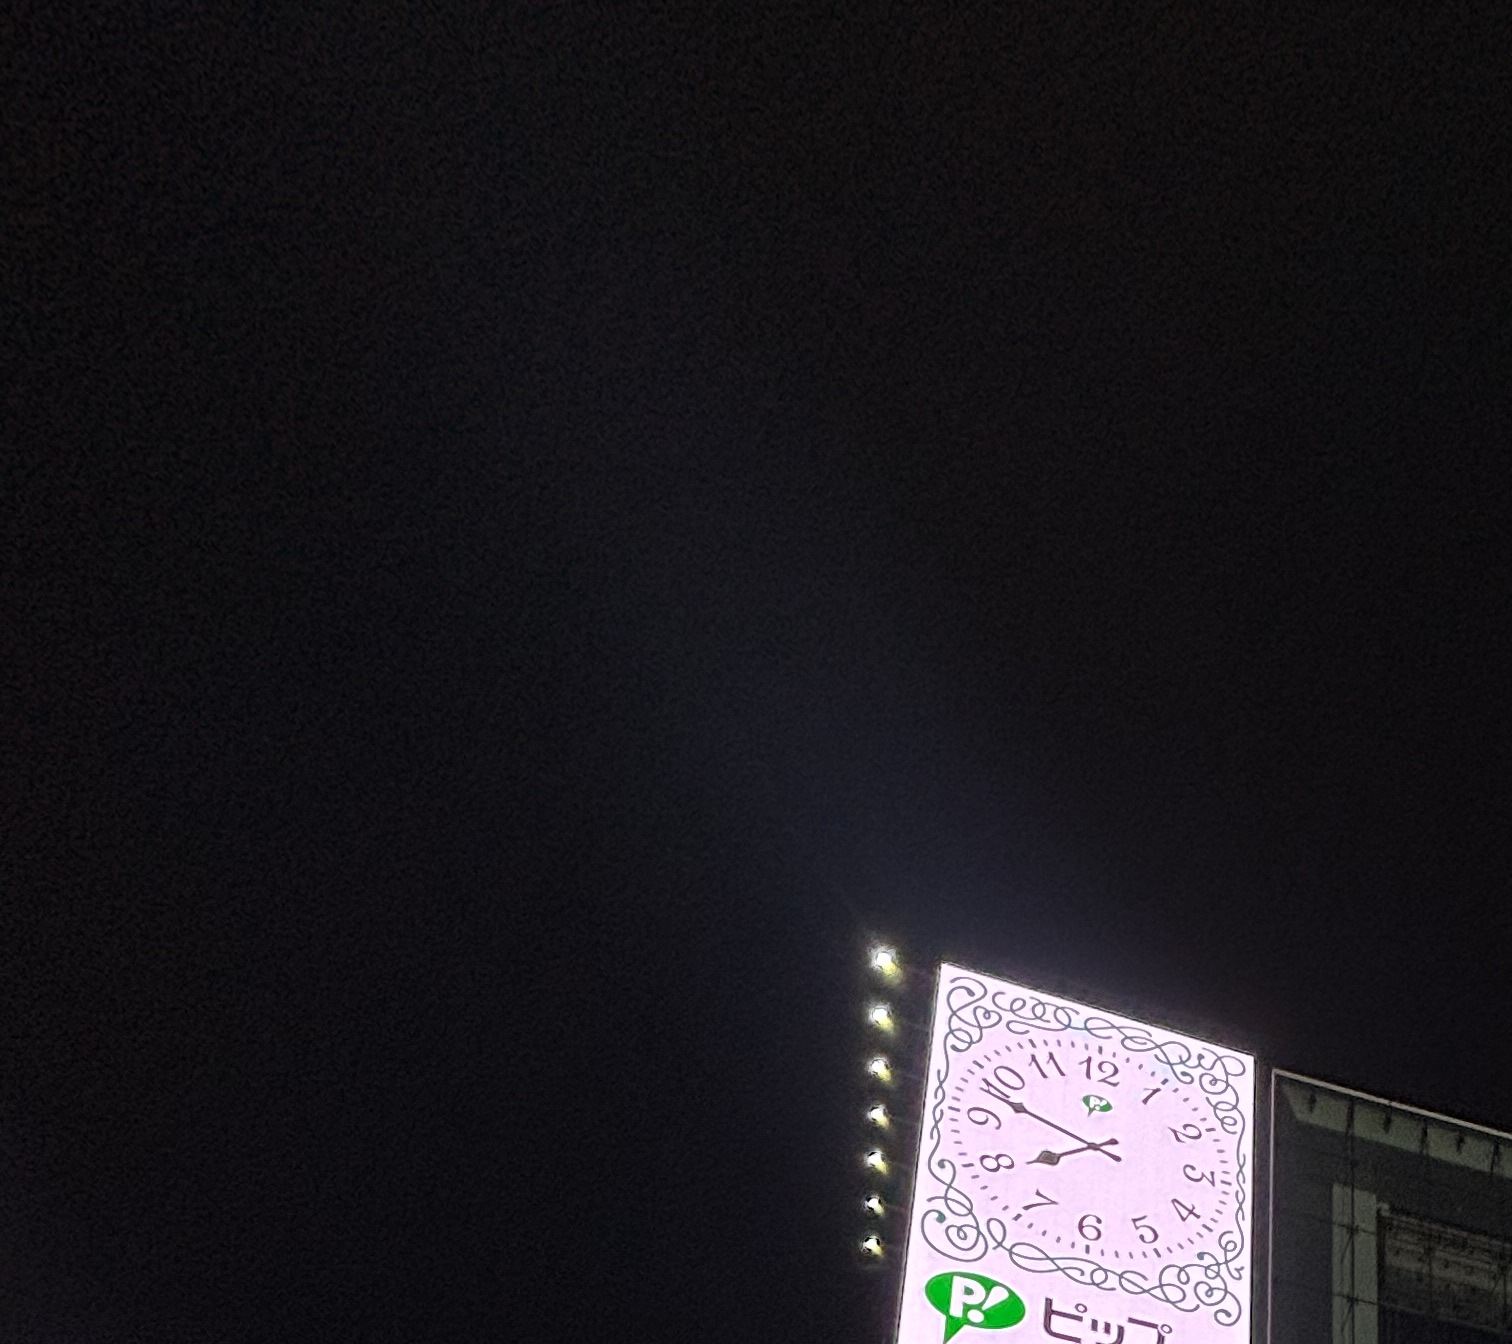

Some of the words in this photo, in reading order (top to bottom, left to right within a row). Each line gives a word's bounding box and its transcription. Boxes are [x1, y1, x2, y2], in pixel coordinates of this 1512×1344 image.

[1028, 1052, 1066, 1080] 11
[1080, 1055, 1121, 1088] 12
[980, 1065, 1026, 1100] 10
[1141, 1087, 1161, 1105] 1
[966, 1106, 1002, 1131] 9
[1169, 1122, 1203, 1145] 2
[979, 1152, 1015, 1174] 8
[1183, 1164, 1216, 1188] 3
[1022, 1190, 1059, 1211] 7
[1171, 1198, 1200, 1223] 4
[1077, 1214, 1103, 1243] 6
[1130, 1215, 1160, 1244] 5
